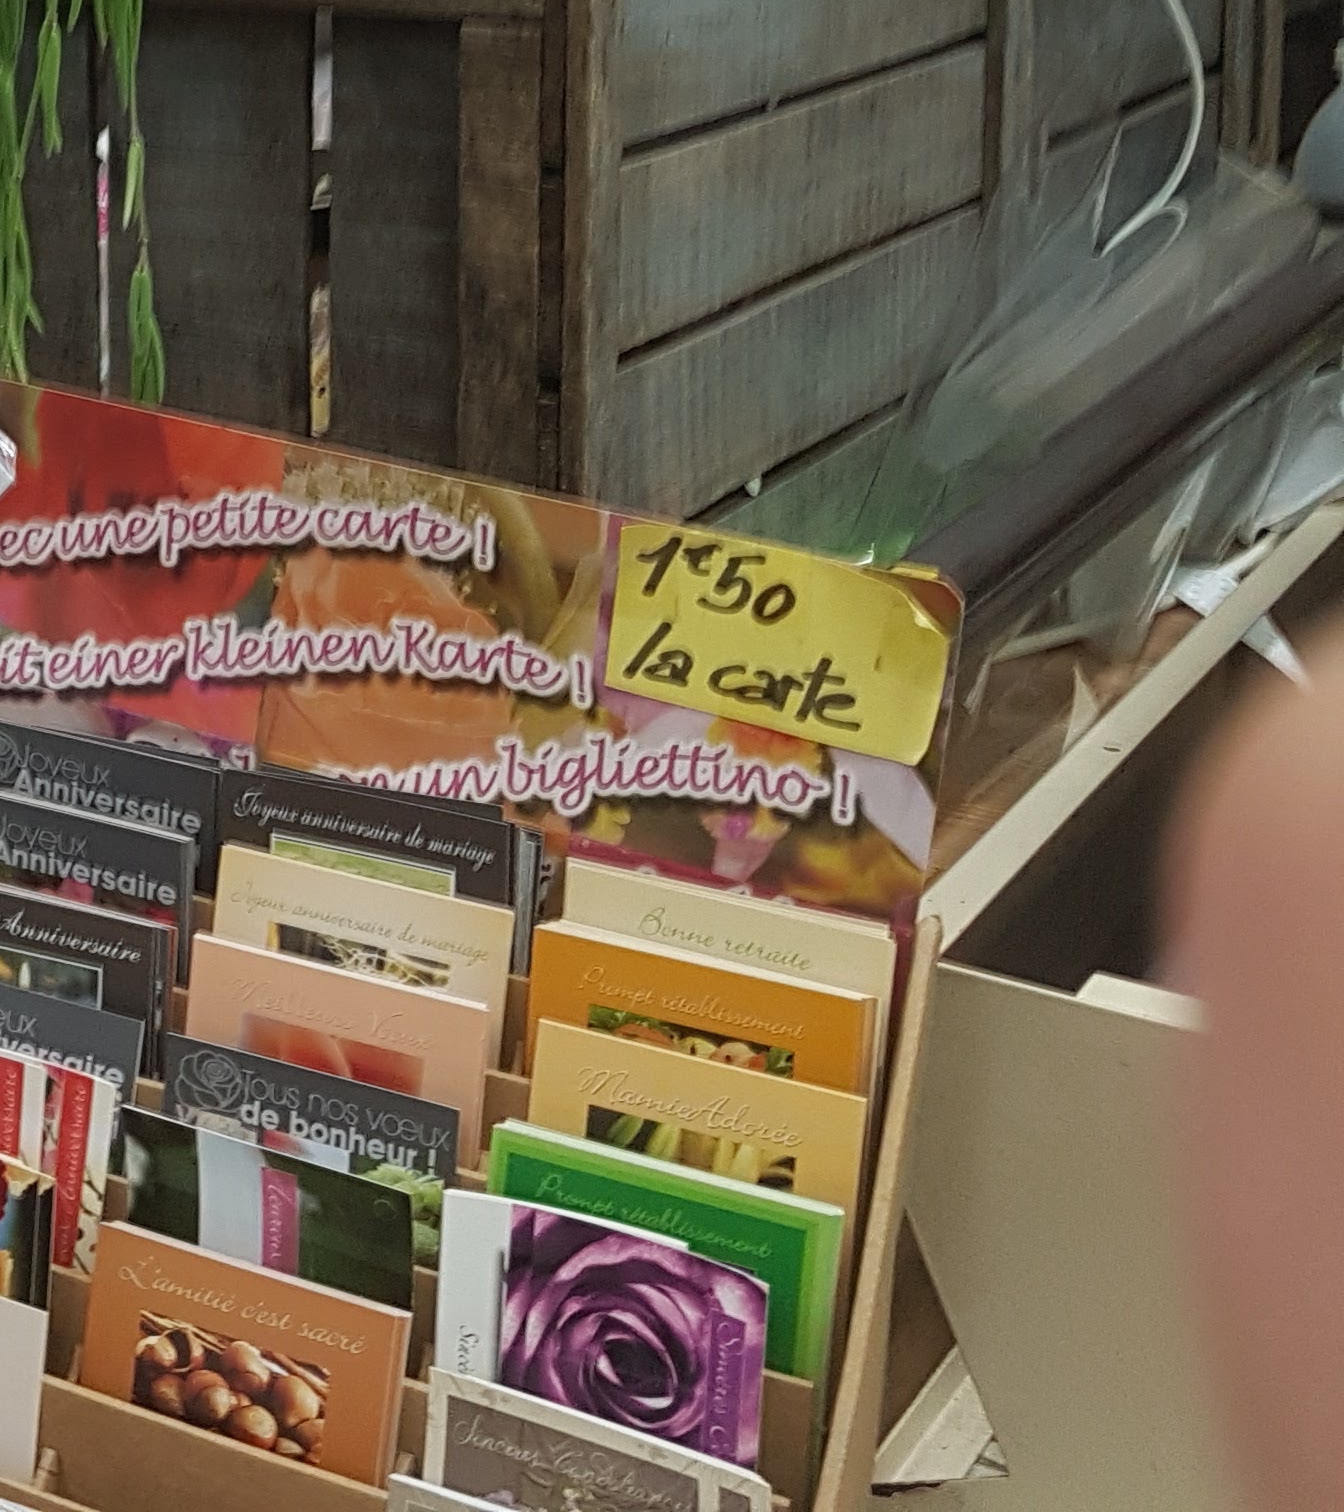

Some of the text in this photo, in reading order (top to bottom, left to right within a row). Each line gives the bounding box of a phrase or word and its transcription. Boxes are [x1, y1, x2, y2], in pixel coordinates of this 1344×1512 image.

[60, 514, 160, 555] une
[164, 495, 308, 563] petite
[316, 509, 468, 554] carte
[49, 638, 180, 683] einer
[188, 618, 395, 672] kleinen
[395, 623, 566, 684] Karte
[623, 622, 862, 732] la carte
[13, 769, 202, 835] Anniversaire
[500, 740, 822, 810] bigliettino
[299, 806, 402, 845] anniversaire
[404, 824, 425, 848] de
[426, 835, 497, 872] mariage
[638, 906, 813, 972] Bonne retraite
[579, 965, 656, 1009] Prompt
[240, 1100, 281, 1131] de
[289, 1112, 419, 1167] bonheur
[307, 1091, 359, 1124] nos
[577, 1066, 803, 1147] Mamie Adorée
[117, 1254, 368, 1356] L'amitié c'est sacré
